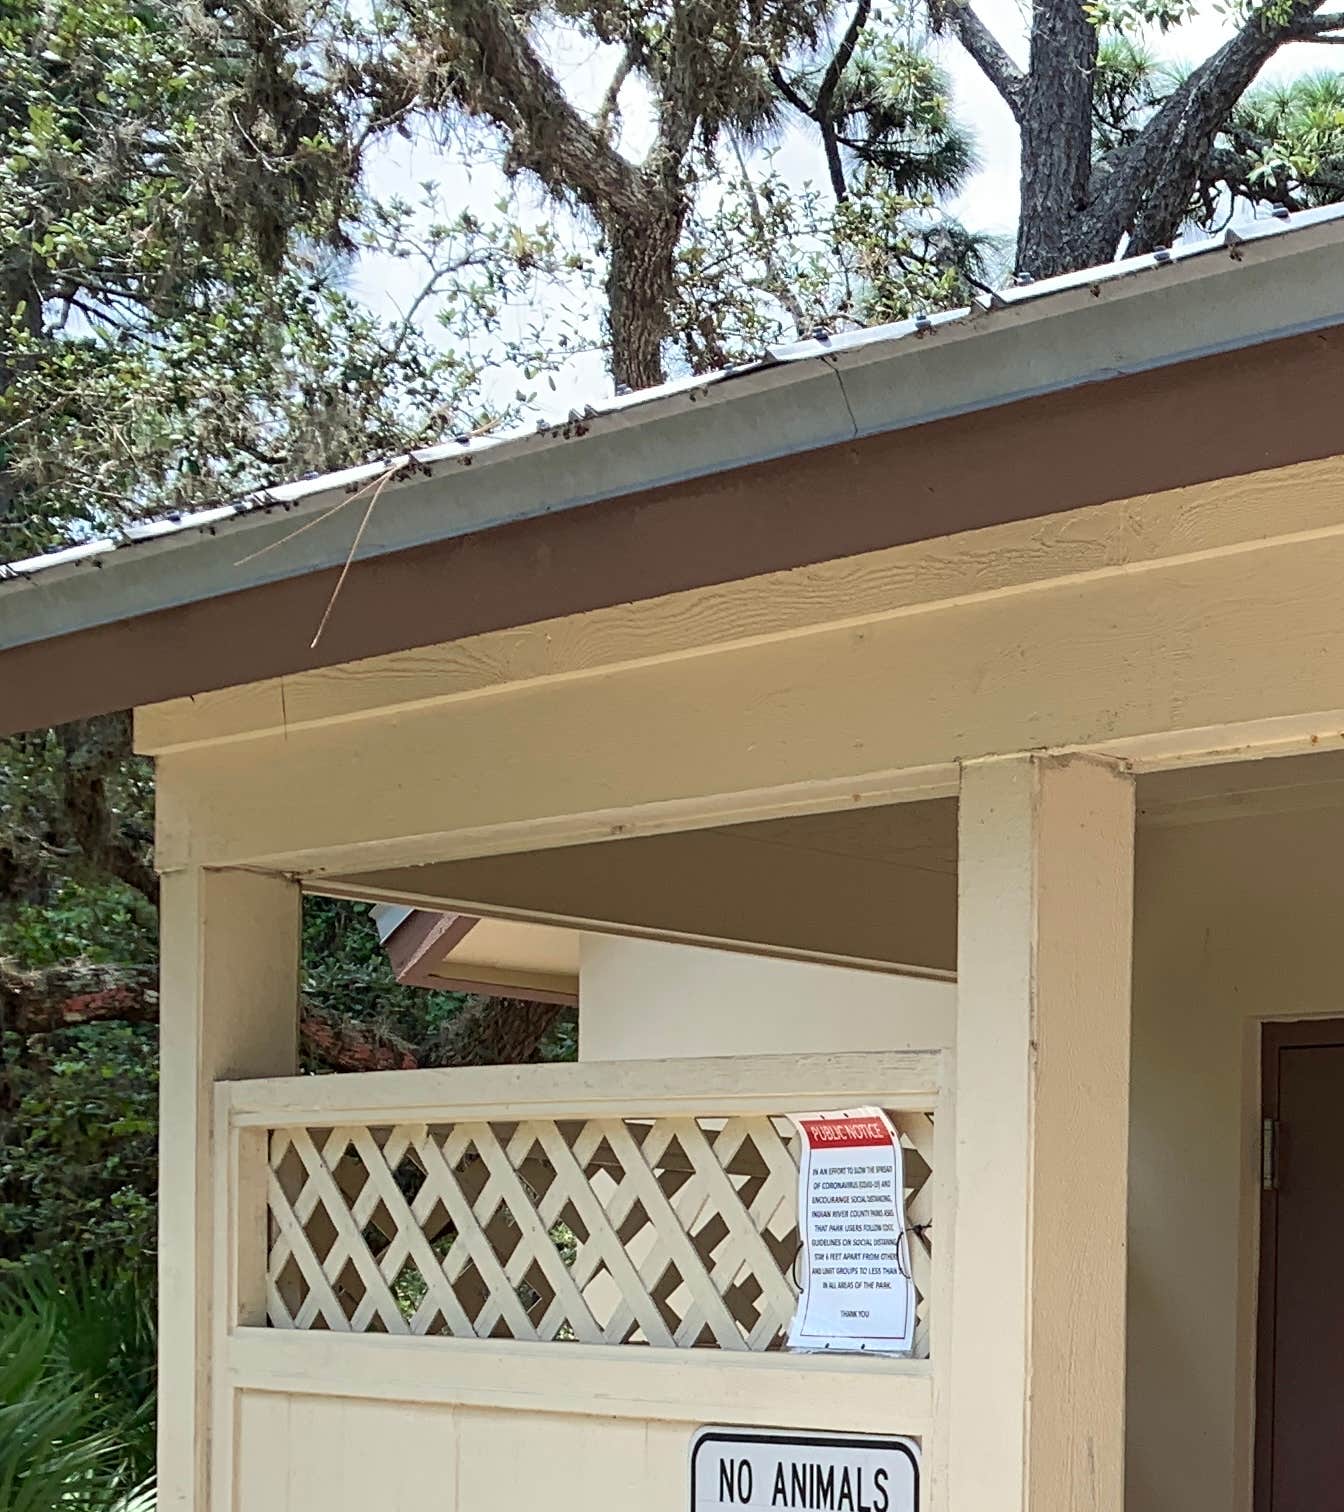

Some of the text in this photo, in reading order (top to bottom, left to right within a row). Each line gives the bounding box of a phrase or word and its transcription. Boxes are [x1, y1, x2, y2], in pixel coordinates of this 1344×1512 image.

[810, 1123, 884, 1141] PUBLIC NOTICE
[719, 1458, 753, 1504] NO
